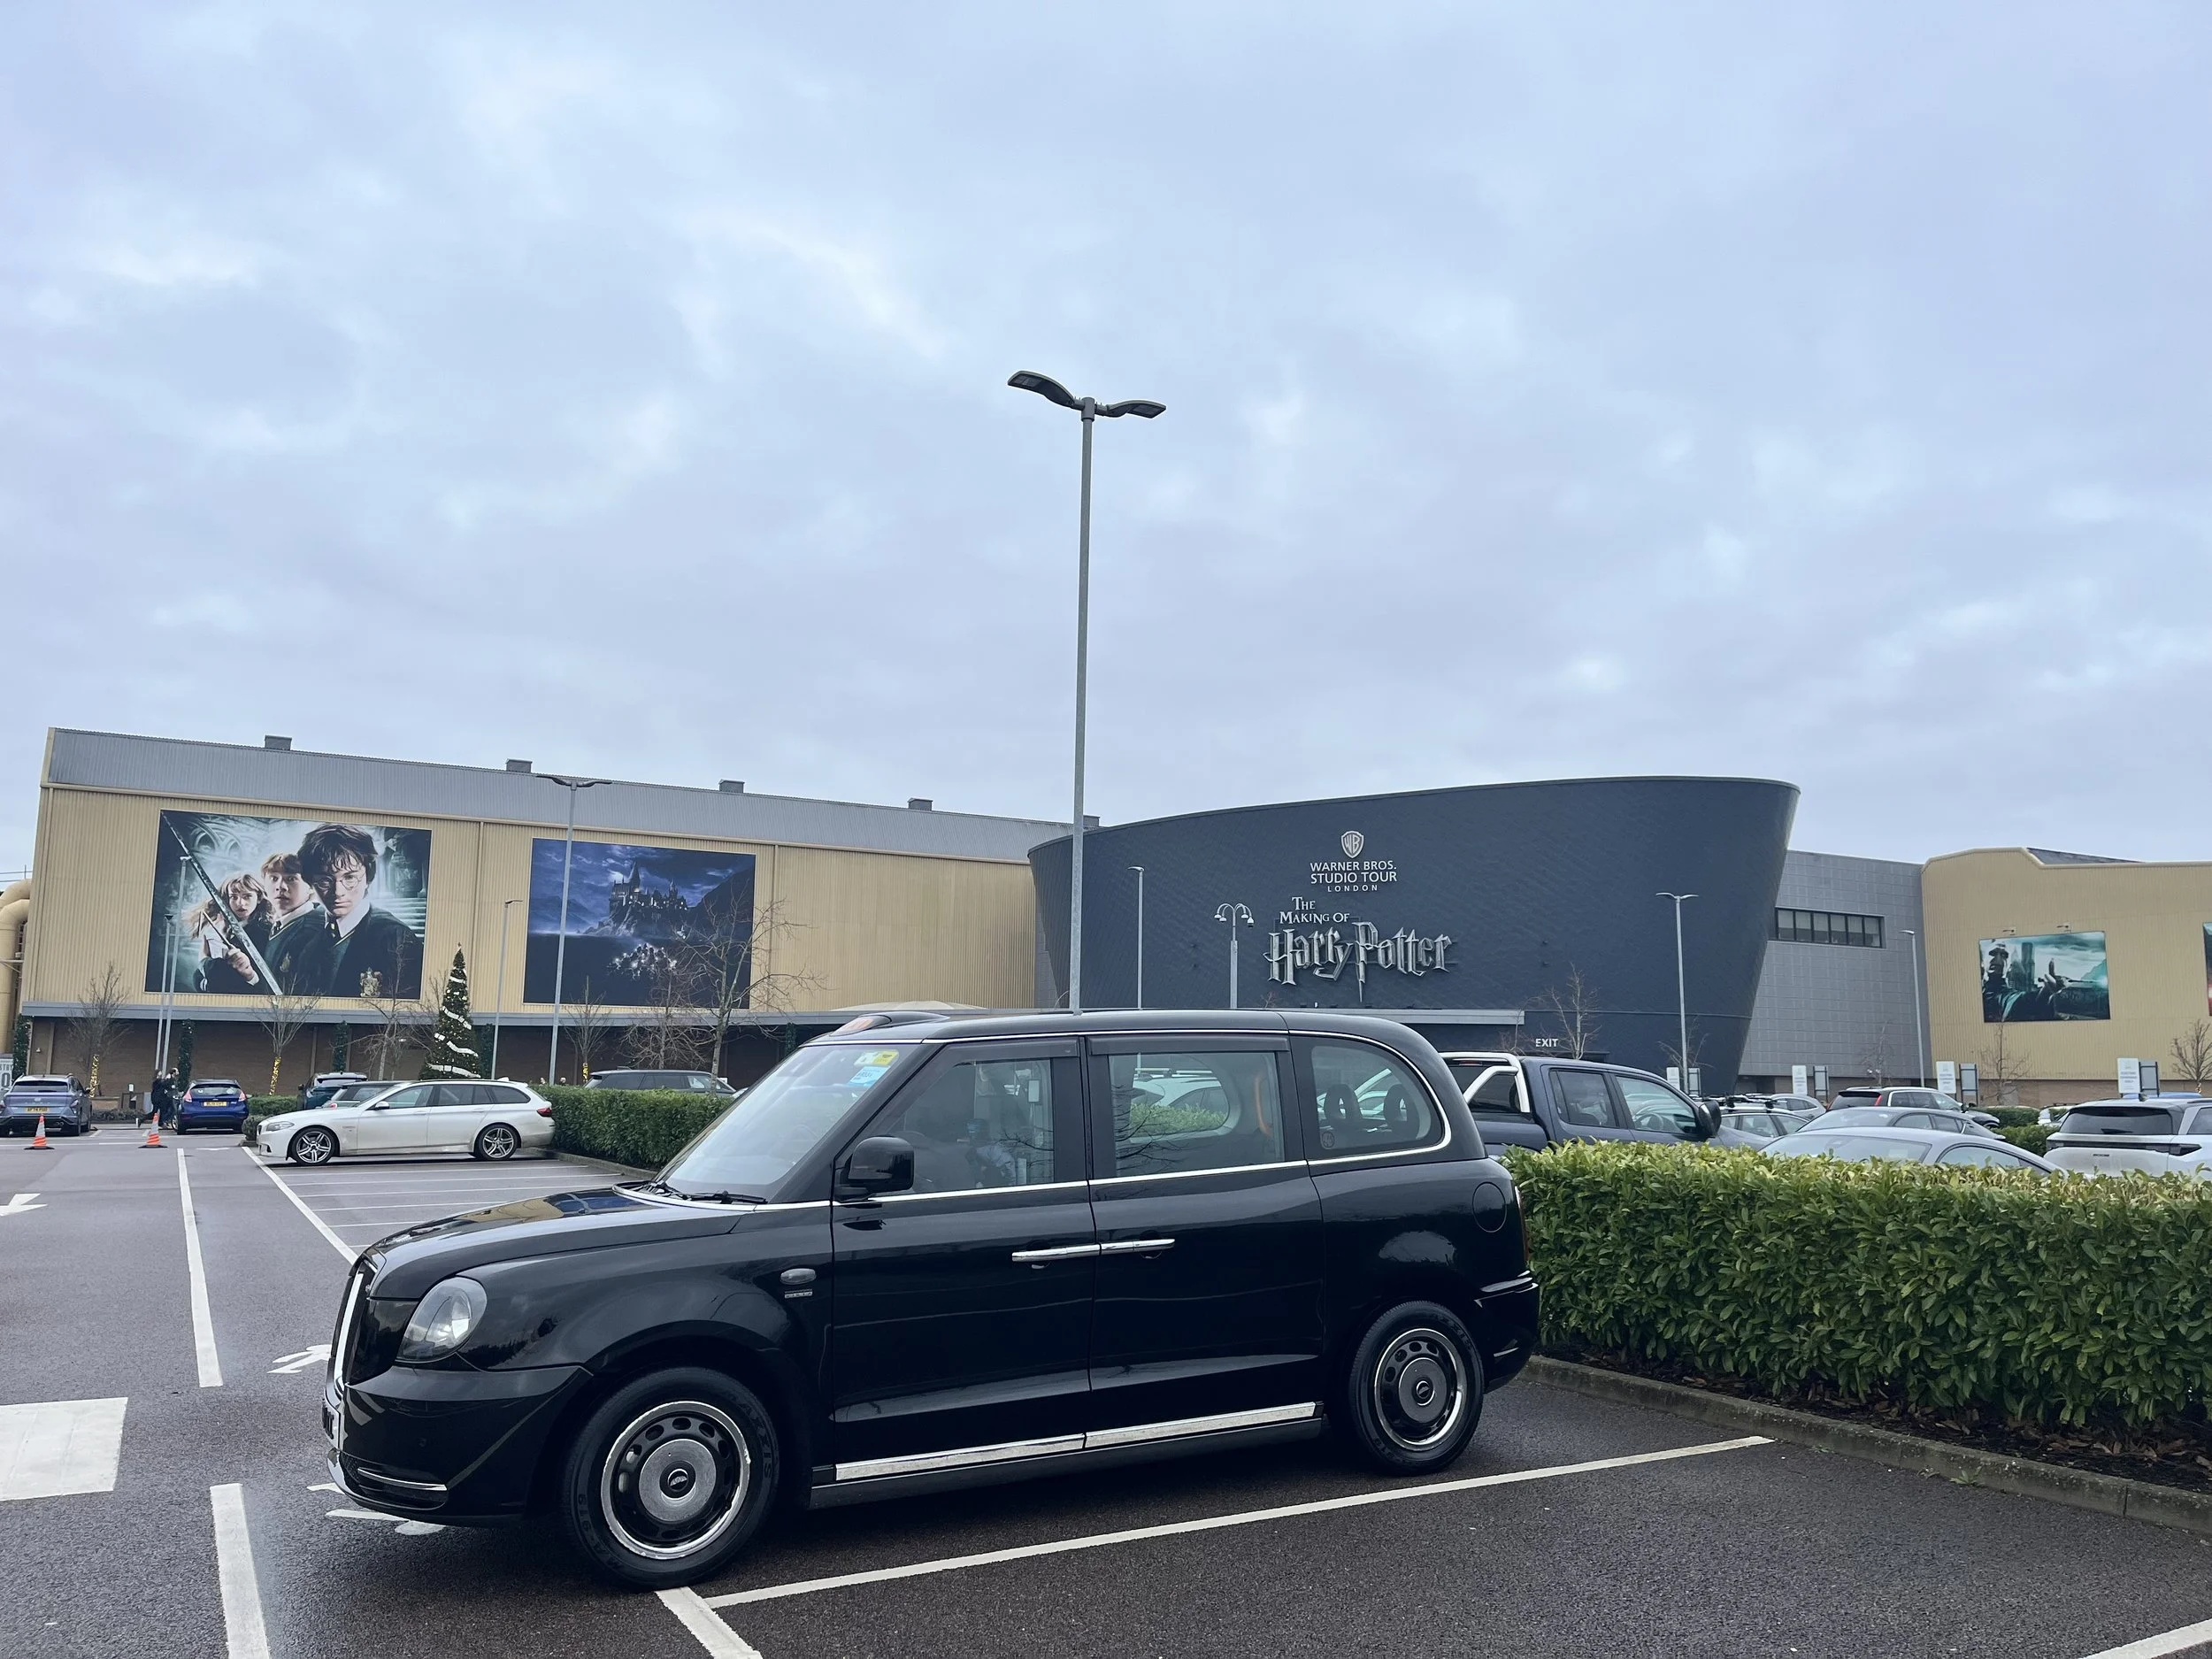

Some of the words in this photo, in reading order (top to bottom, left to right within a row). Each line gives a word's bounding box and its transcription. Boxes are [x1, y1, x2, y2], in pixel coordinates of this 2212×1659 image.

[1310, 862, 1360, 872] WARNER
[1363, 860, 1397, 871] BROS.
[1310, 872, 1357, 884] STUDIO
[1361, 872, 1397, 882] TOUR
[1279, 911, 1330, 925] MAKING
[1333, 912, 1350, 923] OF
[1263, 927, 1354, 986] Harry
[1351, 921, 1452, 1002] Potter
[1535, 1038, 1559, 1048] EXIT
